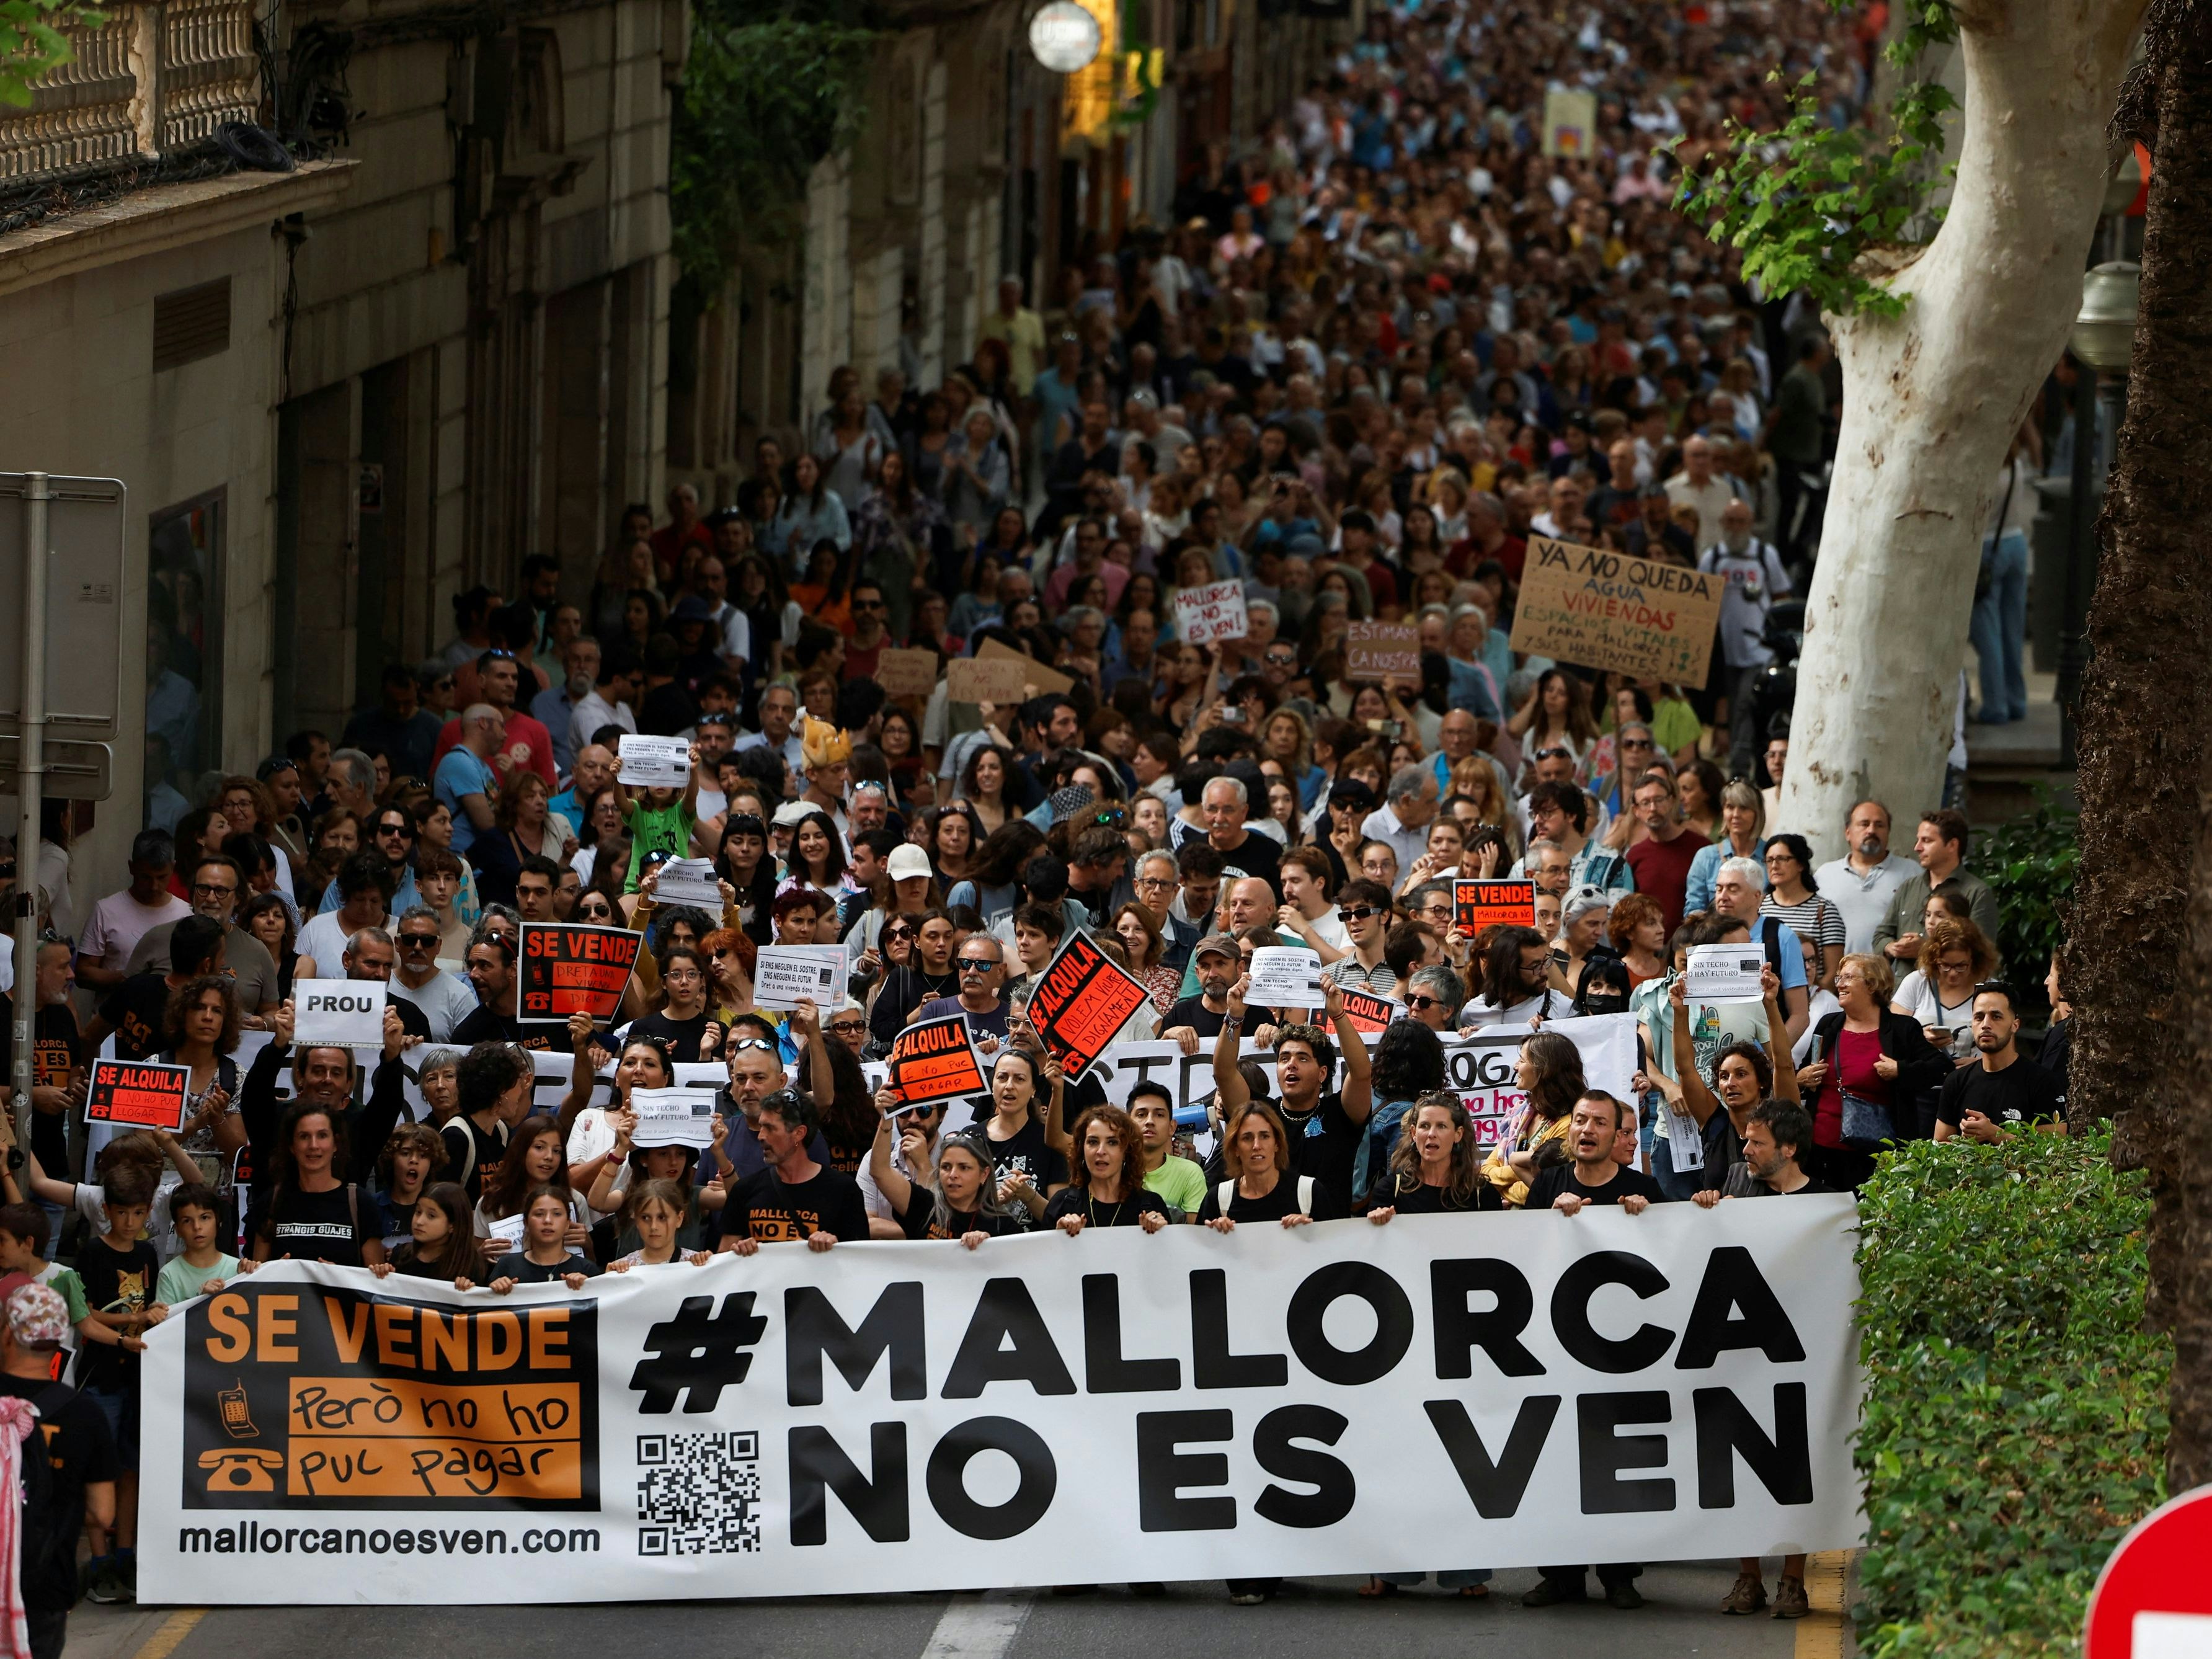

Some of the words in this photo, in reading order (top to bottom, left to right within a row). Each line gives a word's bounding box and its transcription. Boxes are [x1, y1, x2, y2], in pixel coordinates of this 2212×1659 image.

[1538, 543, 1571, 572] YA
[1578, 551, 1620, 578] NO
[1627, 561, 1710, 600] QUEDA
[1584, 579, 1646, 603] AGUA
[1562, 590, 1676, 632] VIVIENDAS
[1457, 886, 1476, 904] SE
[1478, 885, 1533, 904] VENDE
[527, 931, 559, 957] SE
[567, 932, 637, 964] VENDE
[760, 961, 765, 969] SI
[765, 961, 774, 969] ENS
[775, 963, 793, 972] NEGUEN
[793, 964, 798, 972] EL
[799, 965, 817, 976] SOSTRE,
[764, 971, 773, 979] ENS
[774, 972, 791, 982] NEGUEN
[797, 975, 812, 984] FUTUR
[1039, 941, 1100, 1018] ALQUILA
[761, 981, 771, 990] Dret
[308, 995, 372, 1013] PROU
[1061, 994, 1101, 1034] VOLEM
[1082, 983, 1137, 1047] DIGNAMENT
[1342, 992, 1389, 1022] LQUILA
[1030, 1000, 1049, 1035] SE
[1364, 1021, 1377, 1032] PUC
[33, 1039, 68, 1049] LORCA
[902, 1023, 967, 1057] ALQUILA
[47, 1052, 67, 1066] ES
[922, 1065, 938, 1076] NO
[33, 1074, 54, 1086] EN
[97, 1065, 118, 1085] SE
[120, 1068, 183, 1092] ALQUILA
[919, 1078, 964, 1093] PAGAR
[126, 1093, 140, 1103] NO
[144, 1095, 156, 1103] HO
[161, 1095, 177, 1106] PUC
[116, 1107, 157, 1120] LLOGAR
[750, 1209, 819, 1222] MALLOCA
[276, 1225, 316, 1234] STRANGIS
[318, 1226, 352, 1237] GUAJES
[752, 1222, 779, 1238] NO
[207, 1294, 299, 1363] SE
[324, 1297, 571, 1371] VENDE
[628, 1247, 1806, 1413] #MALLORCA
[293, 1384, 402, 1428] Però
[422, 1399, 477, 1428] no
[503, 1390, 569, 1435] ho
[300, 1449, 383, 1496] puc
[411, 1448, 555, 1496] pagar
[788, 1415, 1057, 1546] NO
[1136, 1404, 1356, 1532] ES
[1423, 1382, 1814, 1519] VEN
[180, 1521, 600, 1554] mallorcanoesven.com
